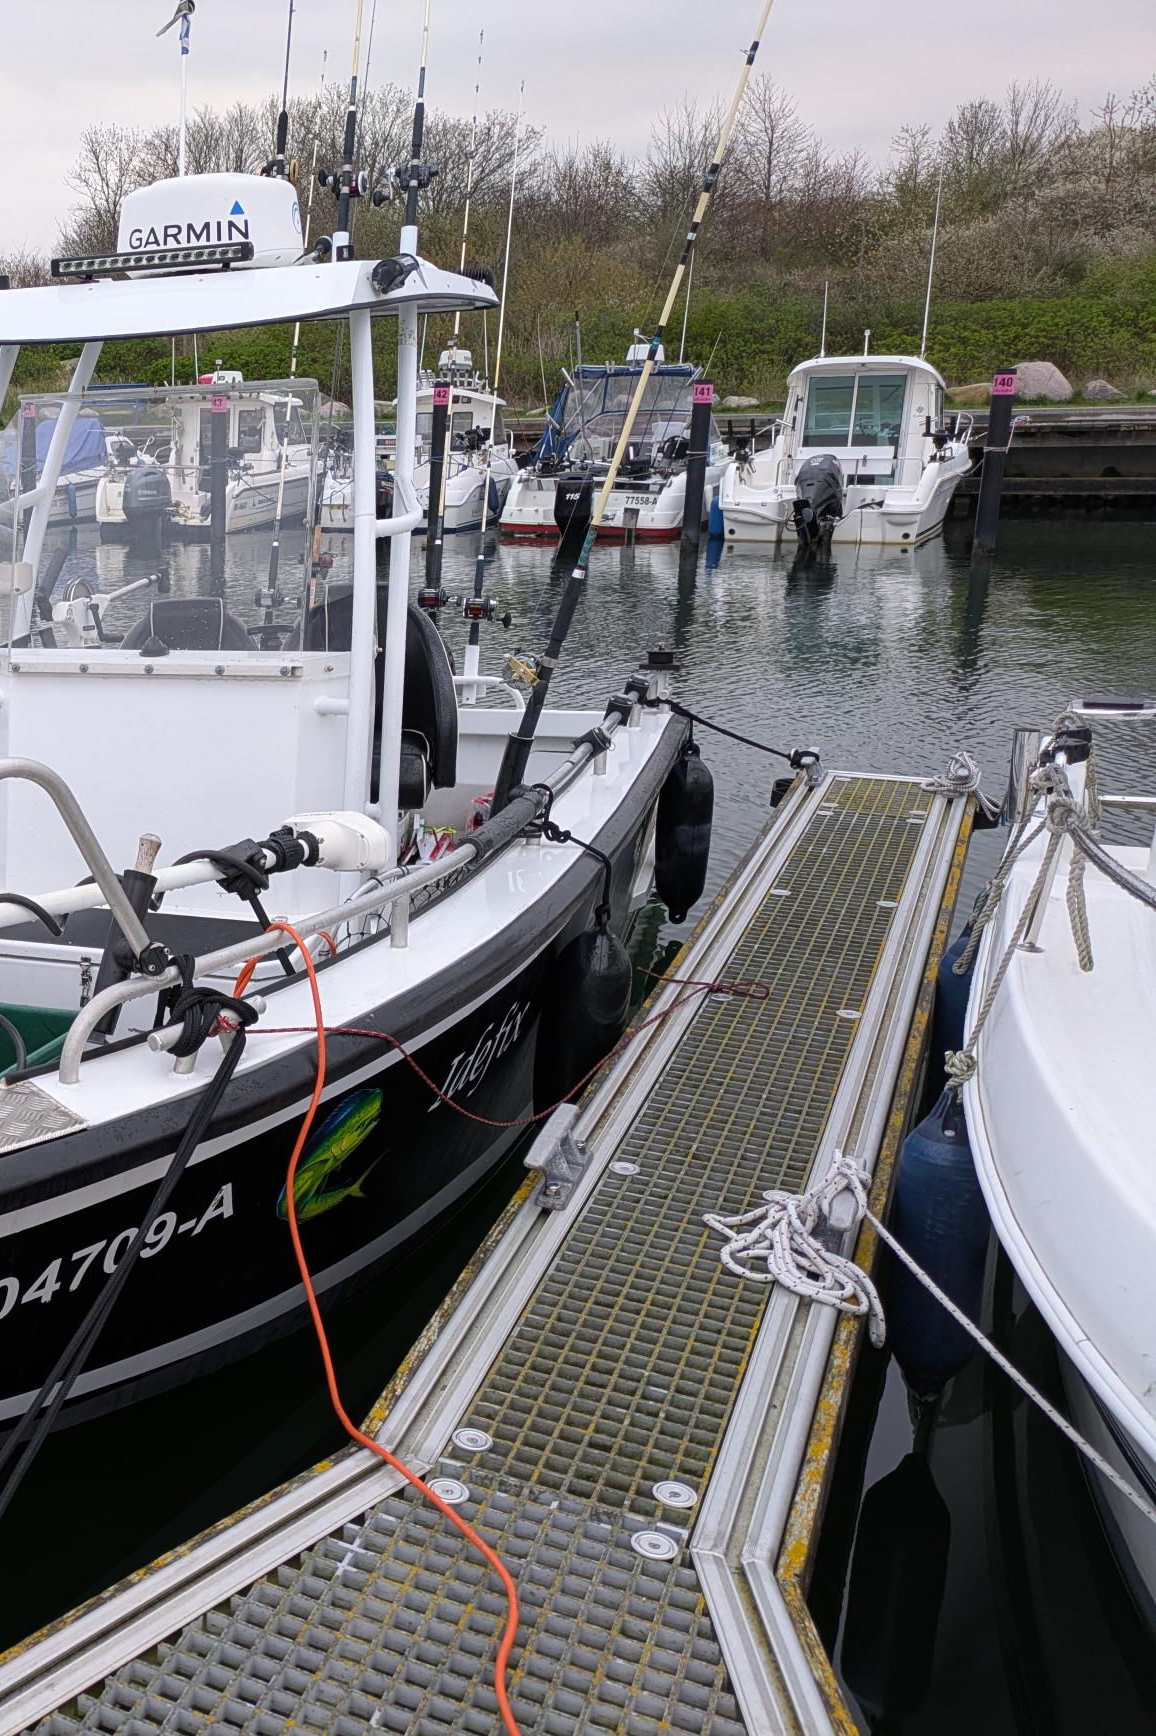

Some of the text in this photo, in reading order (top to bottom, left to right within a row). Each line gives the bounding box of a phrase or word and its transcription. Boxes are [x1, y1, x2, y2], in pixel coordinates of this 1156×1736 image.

[129, 219, 250, 250] GARMIN
[994, 377, 1013, 388] 140
[694, 387, 711, 397] 141
[565, 492, 581, 500] 115
[625, 495, 658, 506] 77558-A
